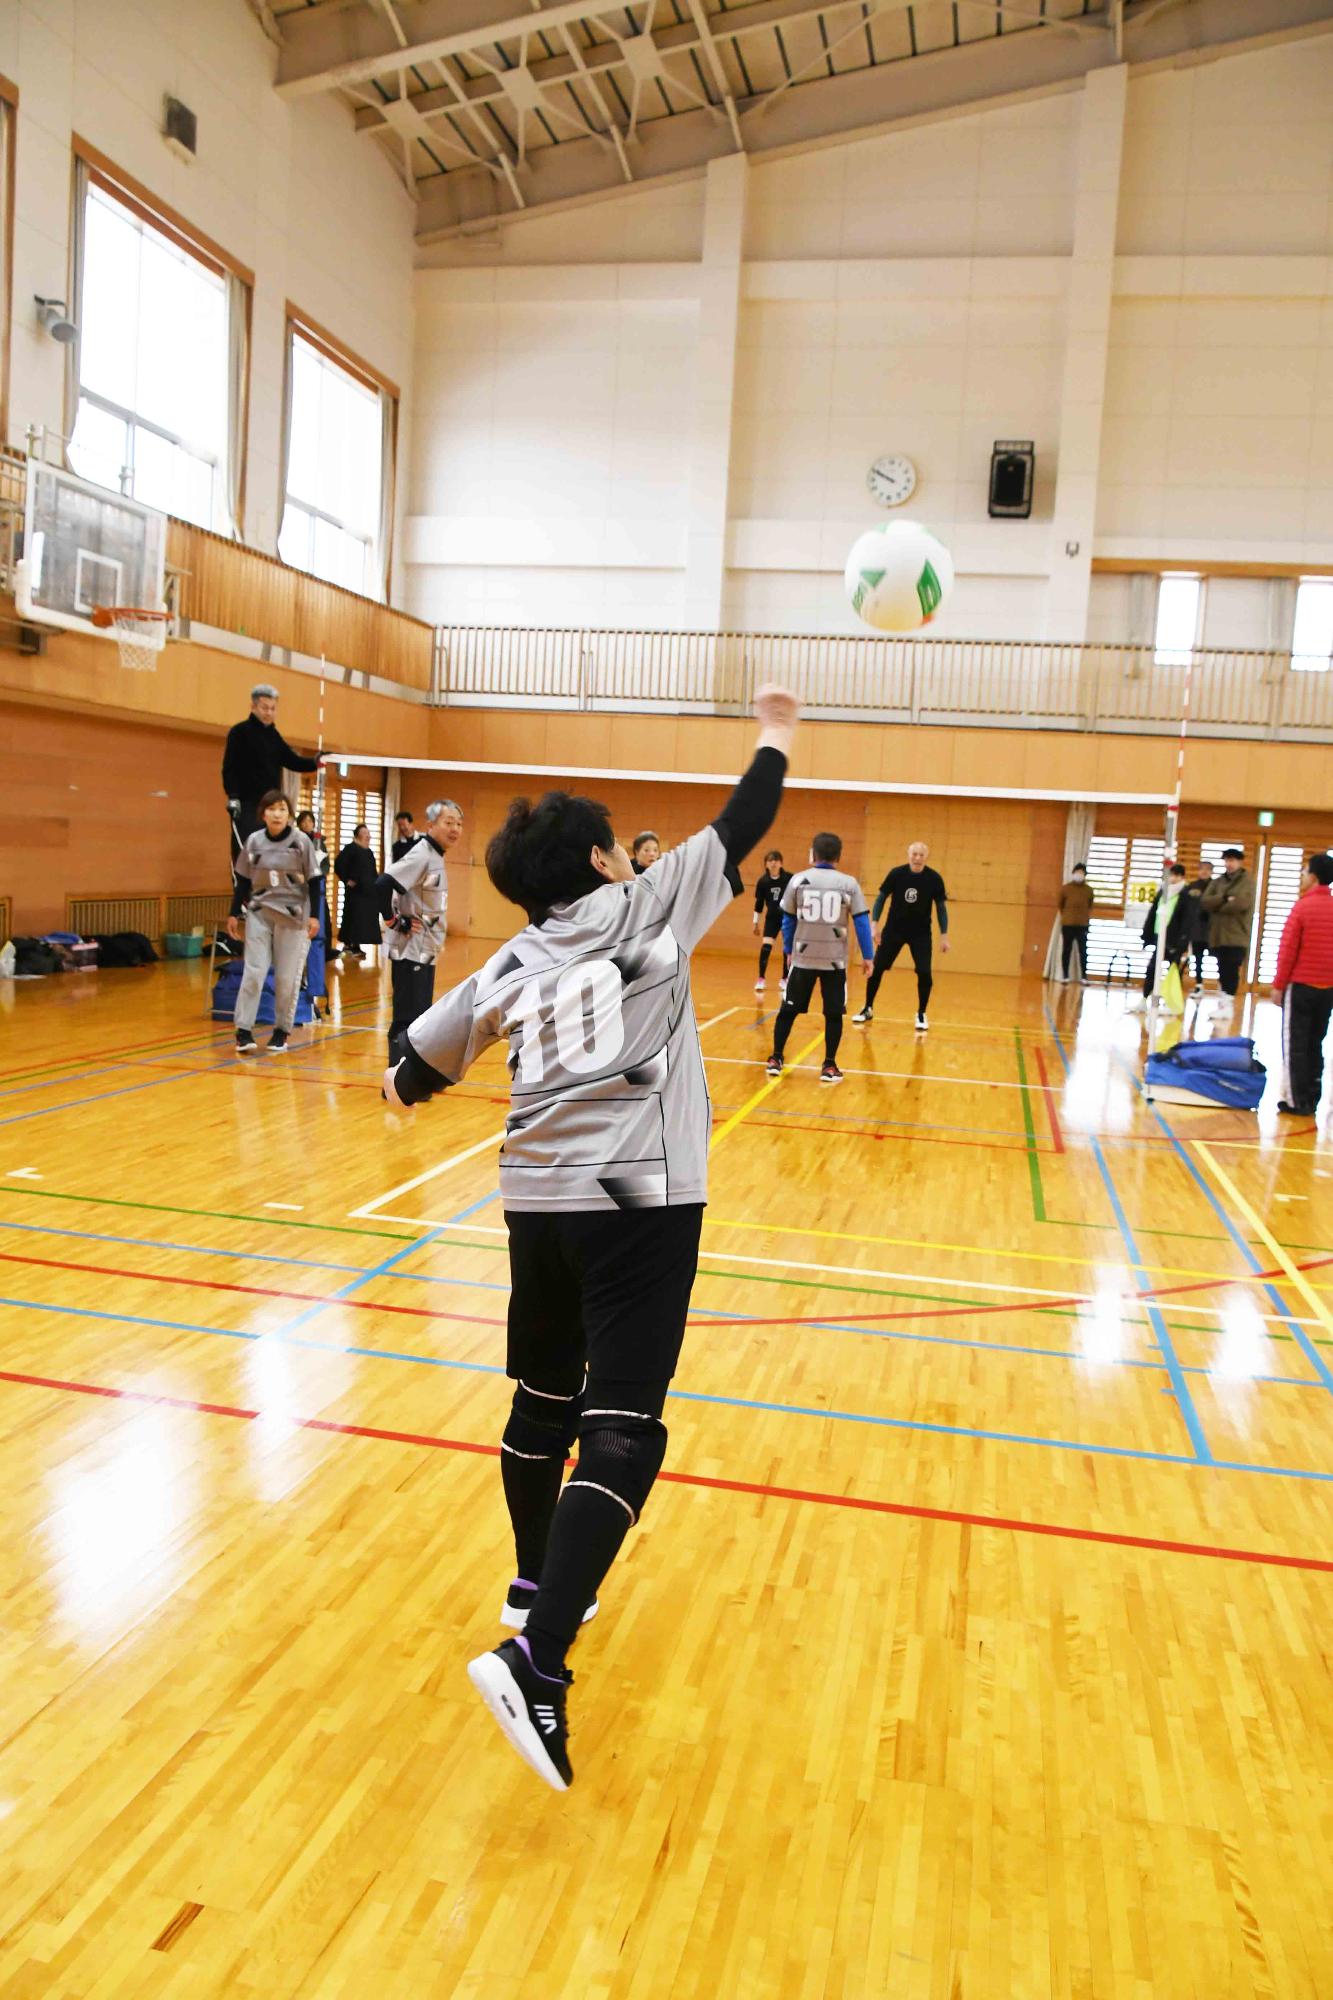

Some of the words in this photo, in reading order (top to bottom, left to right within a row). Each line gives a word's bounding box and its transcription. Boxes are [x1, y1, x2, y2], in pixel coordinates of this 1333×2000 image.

[770, 887, 782, 901] 7
[802, 889, 842, 924] 50
[504, 959, 625, 1085] 10
